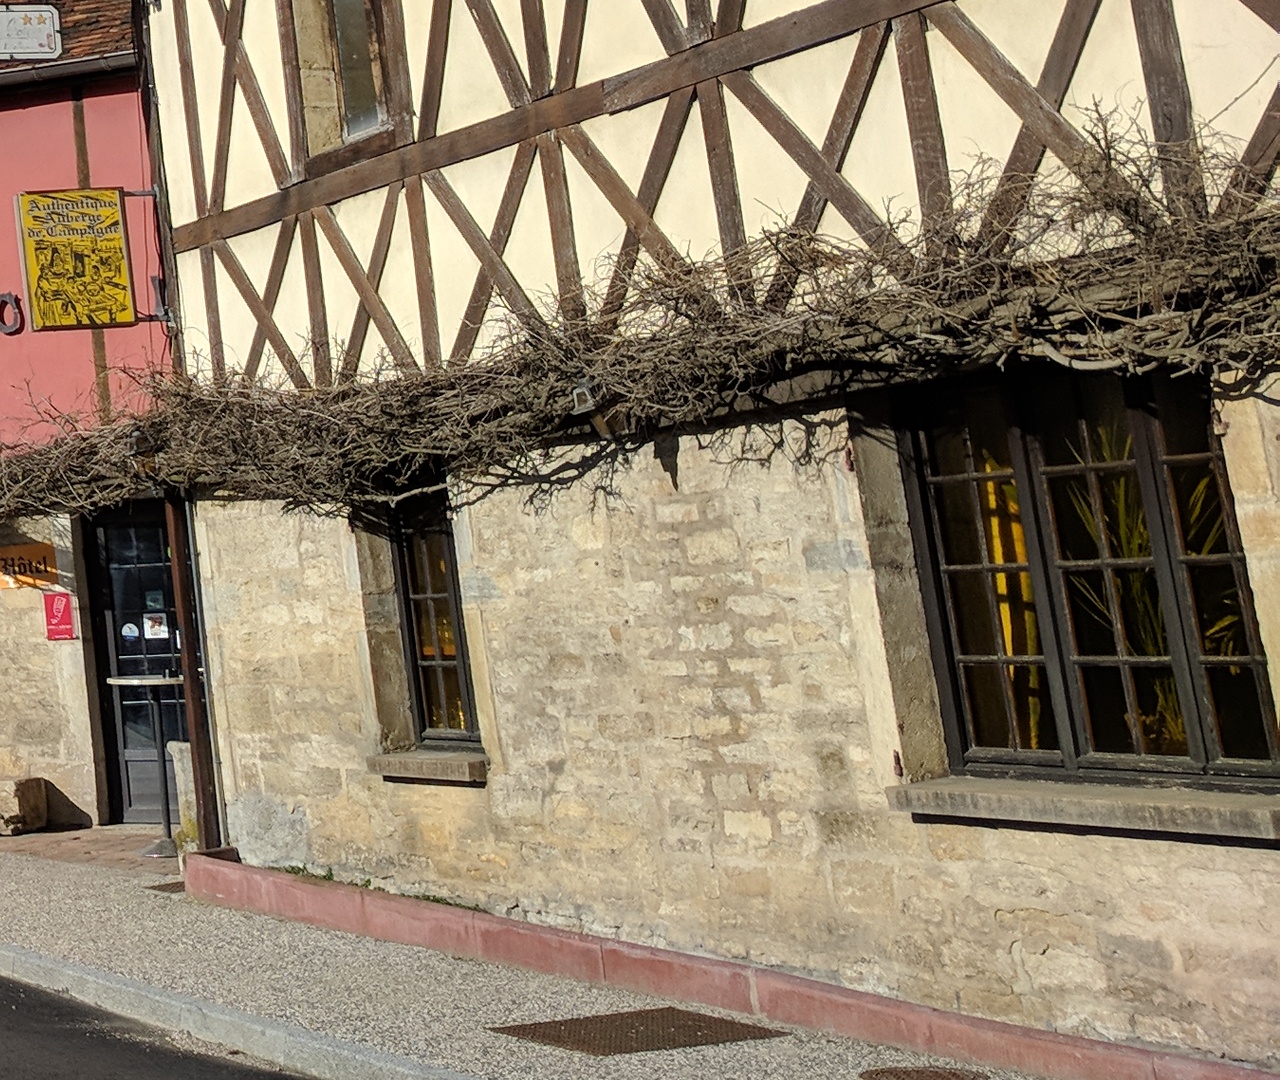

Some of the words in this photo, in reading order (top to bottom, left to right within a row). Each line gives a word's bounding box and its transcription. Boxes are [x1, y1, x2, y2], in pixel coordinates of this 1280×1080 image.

[43, 211, 102, 226] Auberge
[45, 224, 119, 239] Campagne
[0, 555, 50, 576] Hôtel
